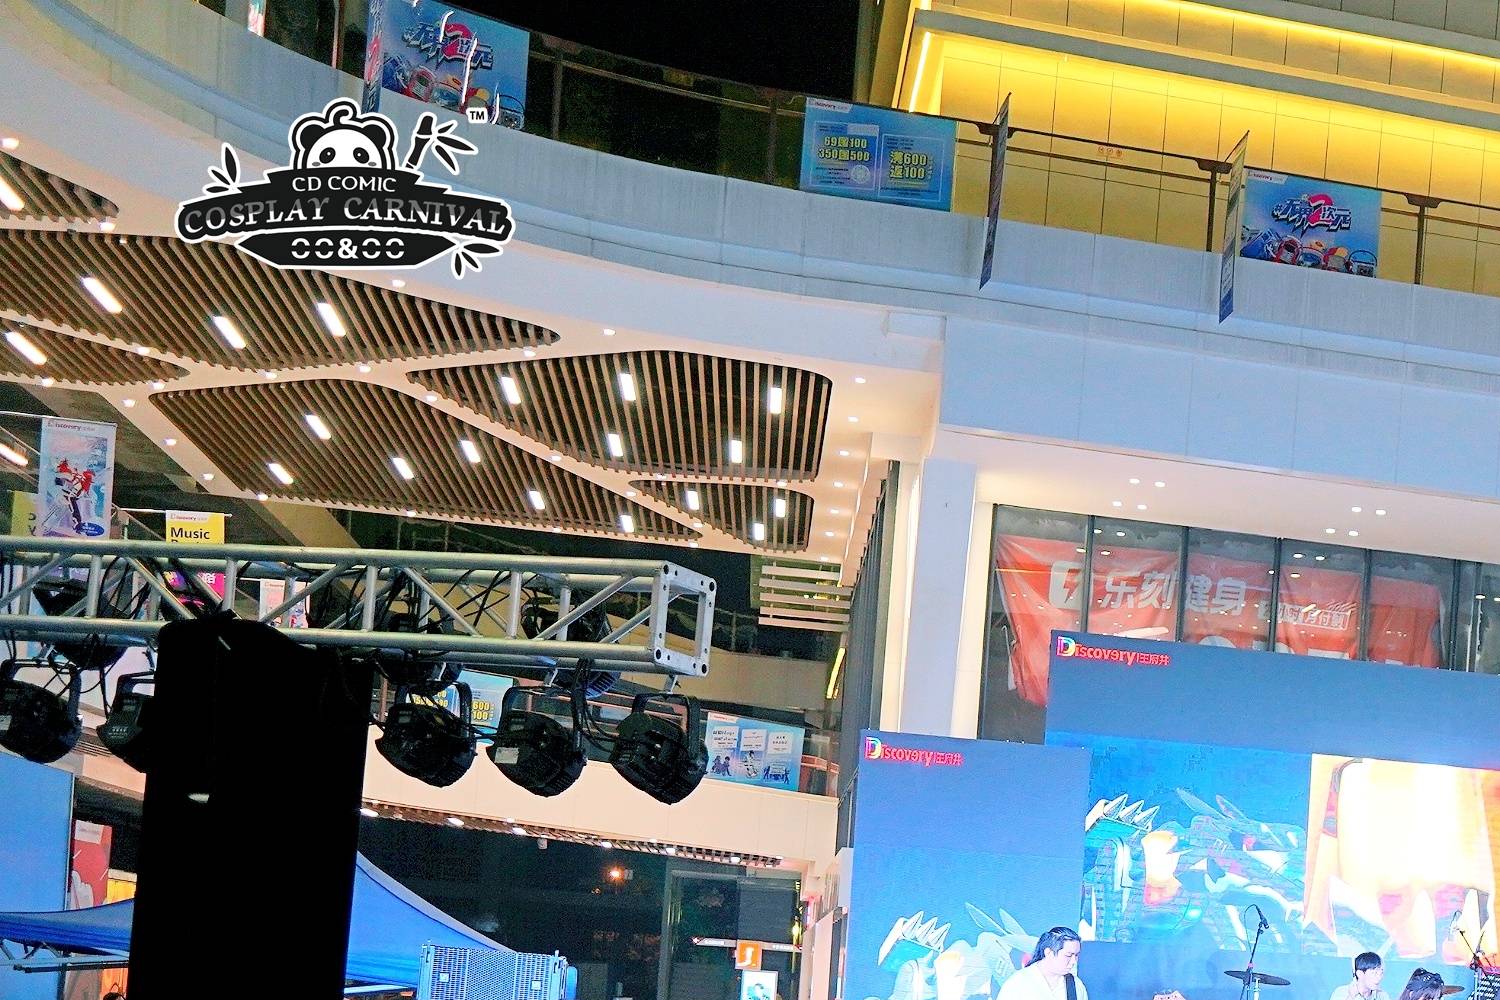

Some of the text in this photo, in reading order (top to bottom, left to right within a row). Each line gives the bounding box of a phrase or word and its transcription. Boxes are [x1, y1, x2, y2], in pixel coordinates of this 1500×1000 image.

[170, 526, 211, 541] Music
[1056, 635, 1136, 667] Discovery
[865, 735, 932, 767] Discovery
